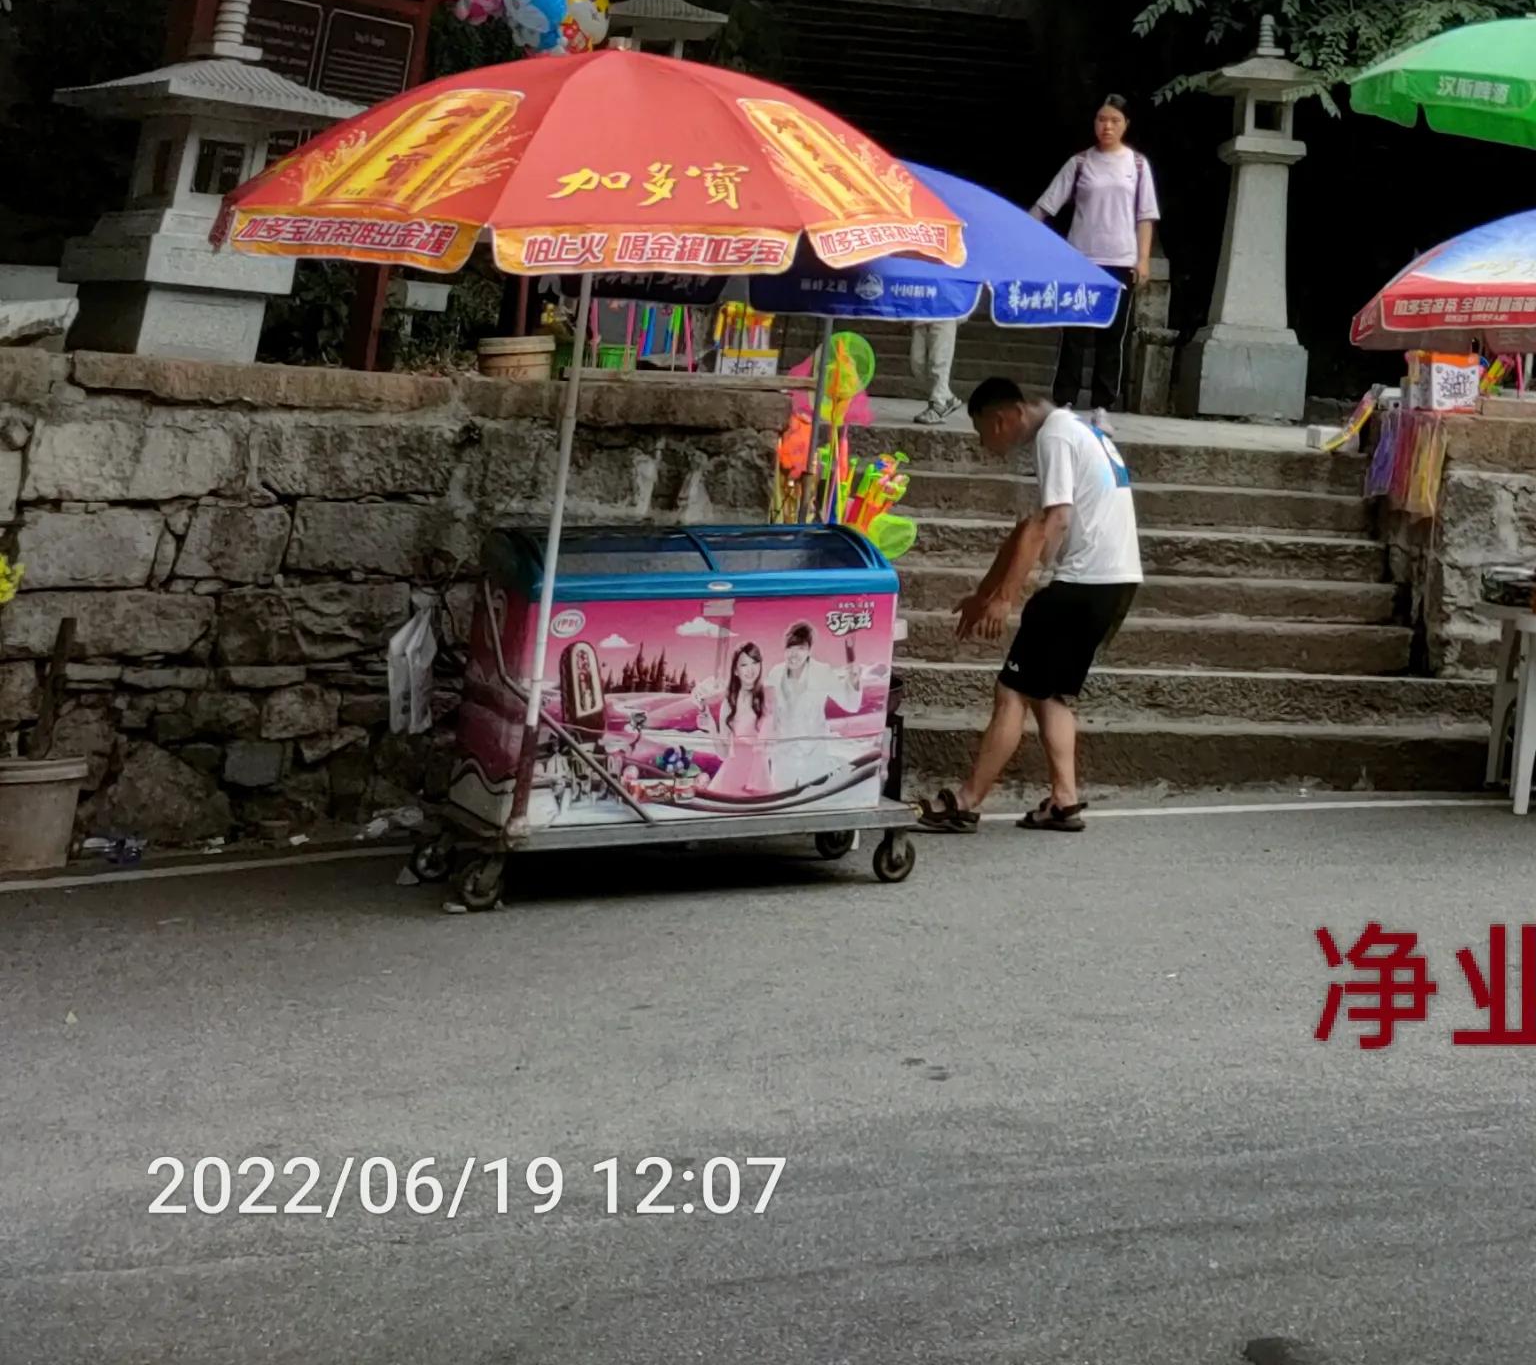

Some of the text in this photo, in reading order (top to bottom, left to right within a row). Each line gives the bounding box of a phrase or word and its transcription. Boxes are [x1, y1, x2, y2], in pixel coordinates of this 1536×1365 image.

[237, 217, 459, 258] 加多宝凉茶推出金罐
[524, 233, 788, 265] 怕上火 喝金罐加多宝
